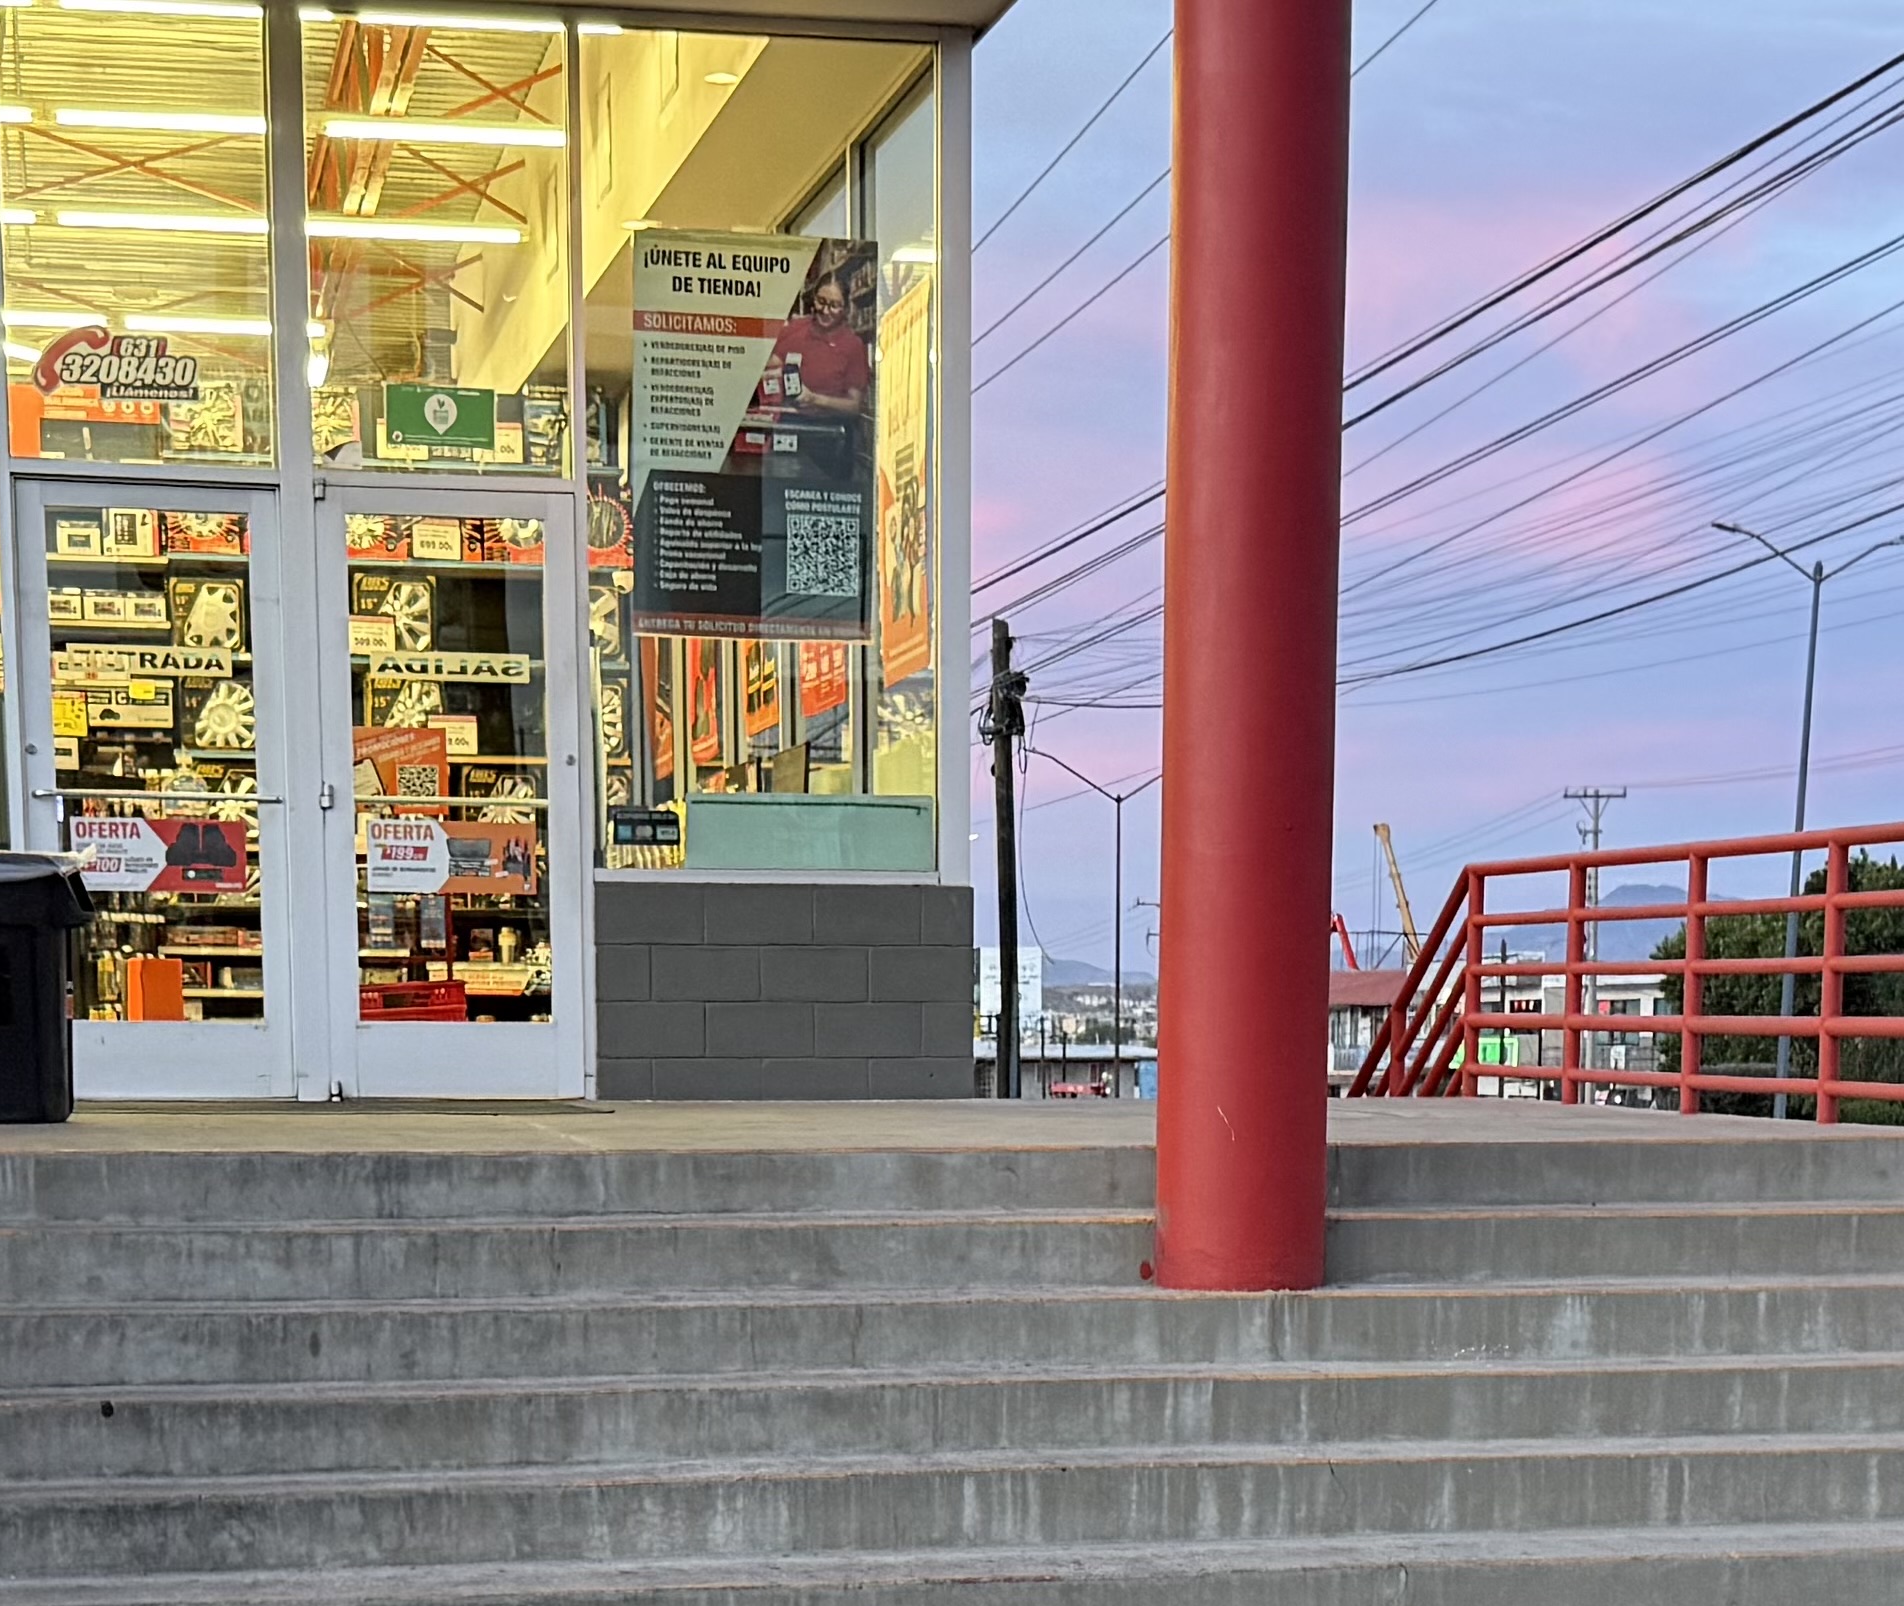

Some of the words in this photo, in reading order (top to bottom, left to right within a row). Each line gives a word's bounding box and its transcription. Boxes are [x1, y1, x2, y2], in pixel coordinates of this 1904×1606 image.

[644, 244, 702, 268] ¡ÚNETE
[706, 252, 726, 270] AL
[732, 254, 790, 274] EQUIPO
[672, 276, 693, 293] DE
[698, 278, 761, 298] TIENDA!
[644, 313, 737, 333] SOLICITAMOS:
[60, 353, 197, 386] 3208430
[75, 821, 141, 839] OFERTA
[371, 823, 434, 840] OFERTA
